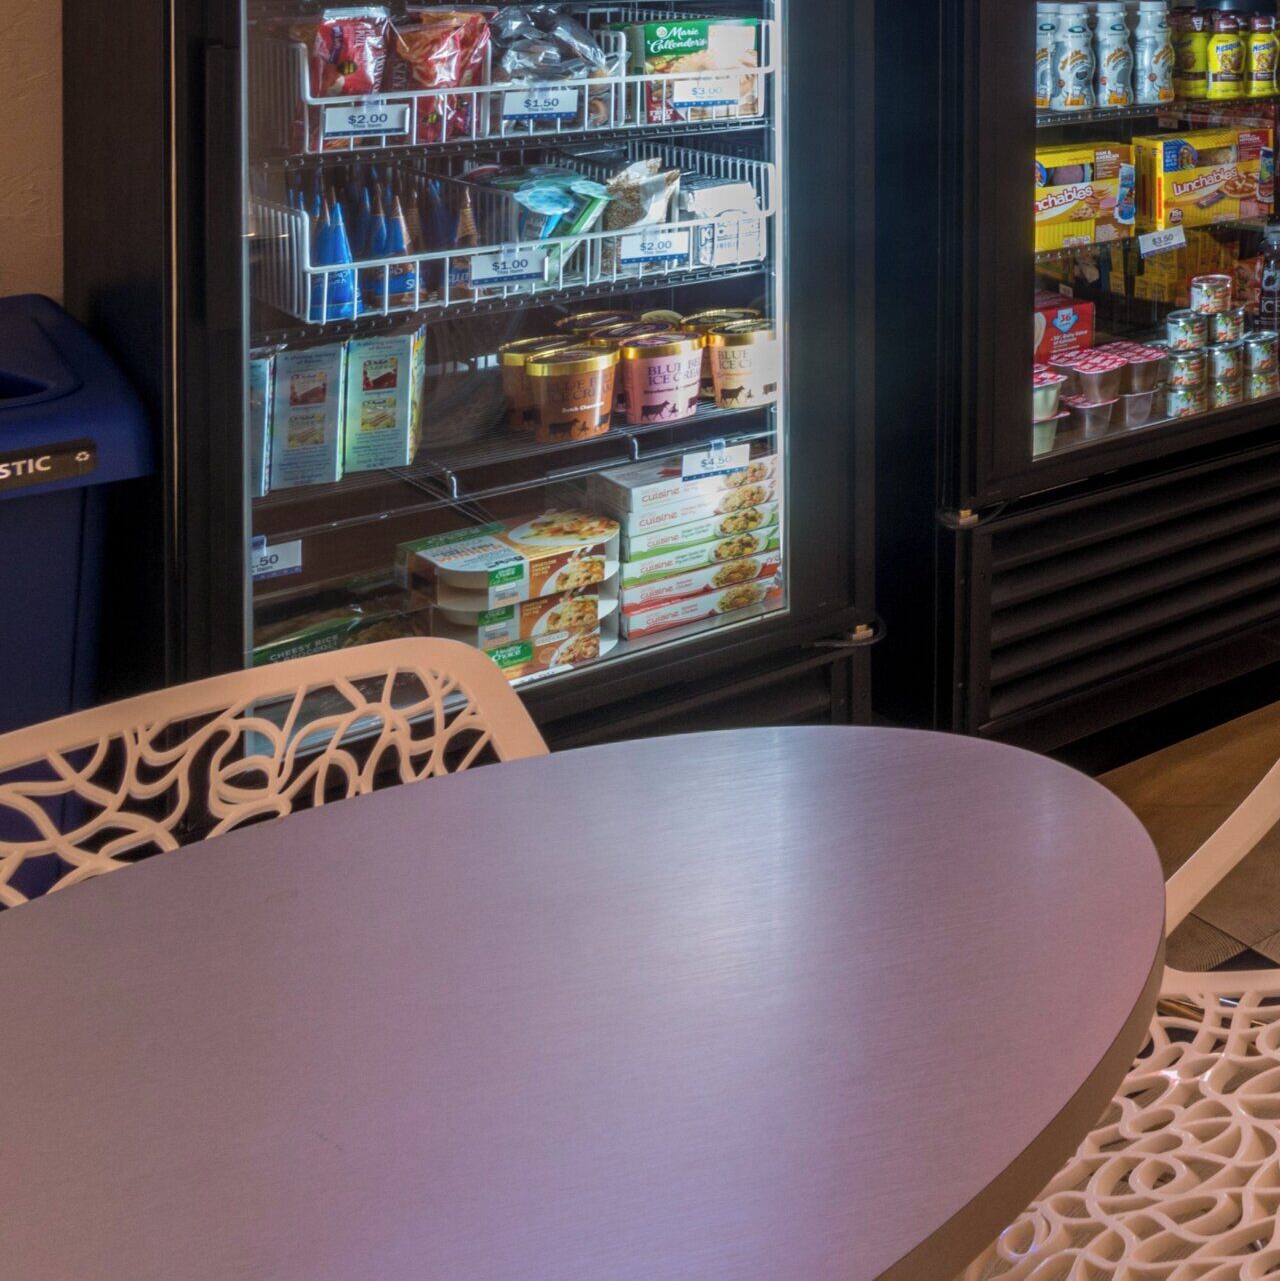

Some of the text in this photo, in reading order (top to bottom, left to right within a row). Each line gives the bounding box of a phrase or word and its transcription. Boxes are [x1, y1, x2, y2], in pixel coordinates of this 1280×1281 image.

[666, 27, 699, 40] Marie
[647, 38, 707, 54] Callender's
[523, 97, 559, 109] $1.50
[348, 114, 389, 125] $2.00
[1171, 167, 1238, 196] Lunchables
[637, 238, 673, 251] $2.00
[1152, 234, 1174, 246] $3.50
[491, 258, 529, 271] $1.00
[648, 374, 669, 386] ICE
[700, 456, 731, 468] $4.50
[641, 486, 681, 503] cuisine
[639, 510, 679, 526] cuisine
[646, 532, 680, 548] cuisine
[640, 558, 674, 574] cuisine
[640, 584, 674, 600] cuisine
[646, 609, 680, 625] cuisine
[314, 633, 339, 649] RICE
